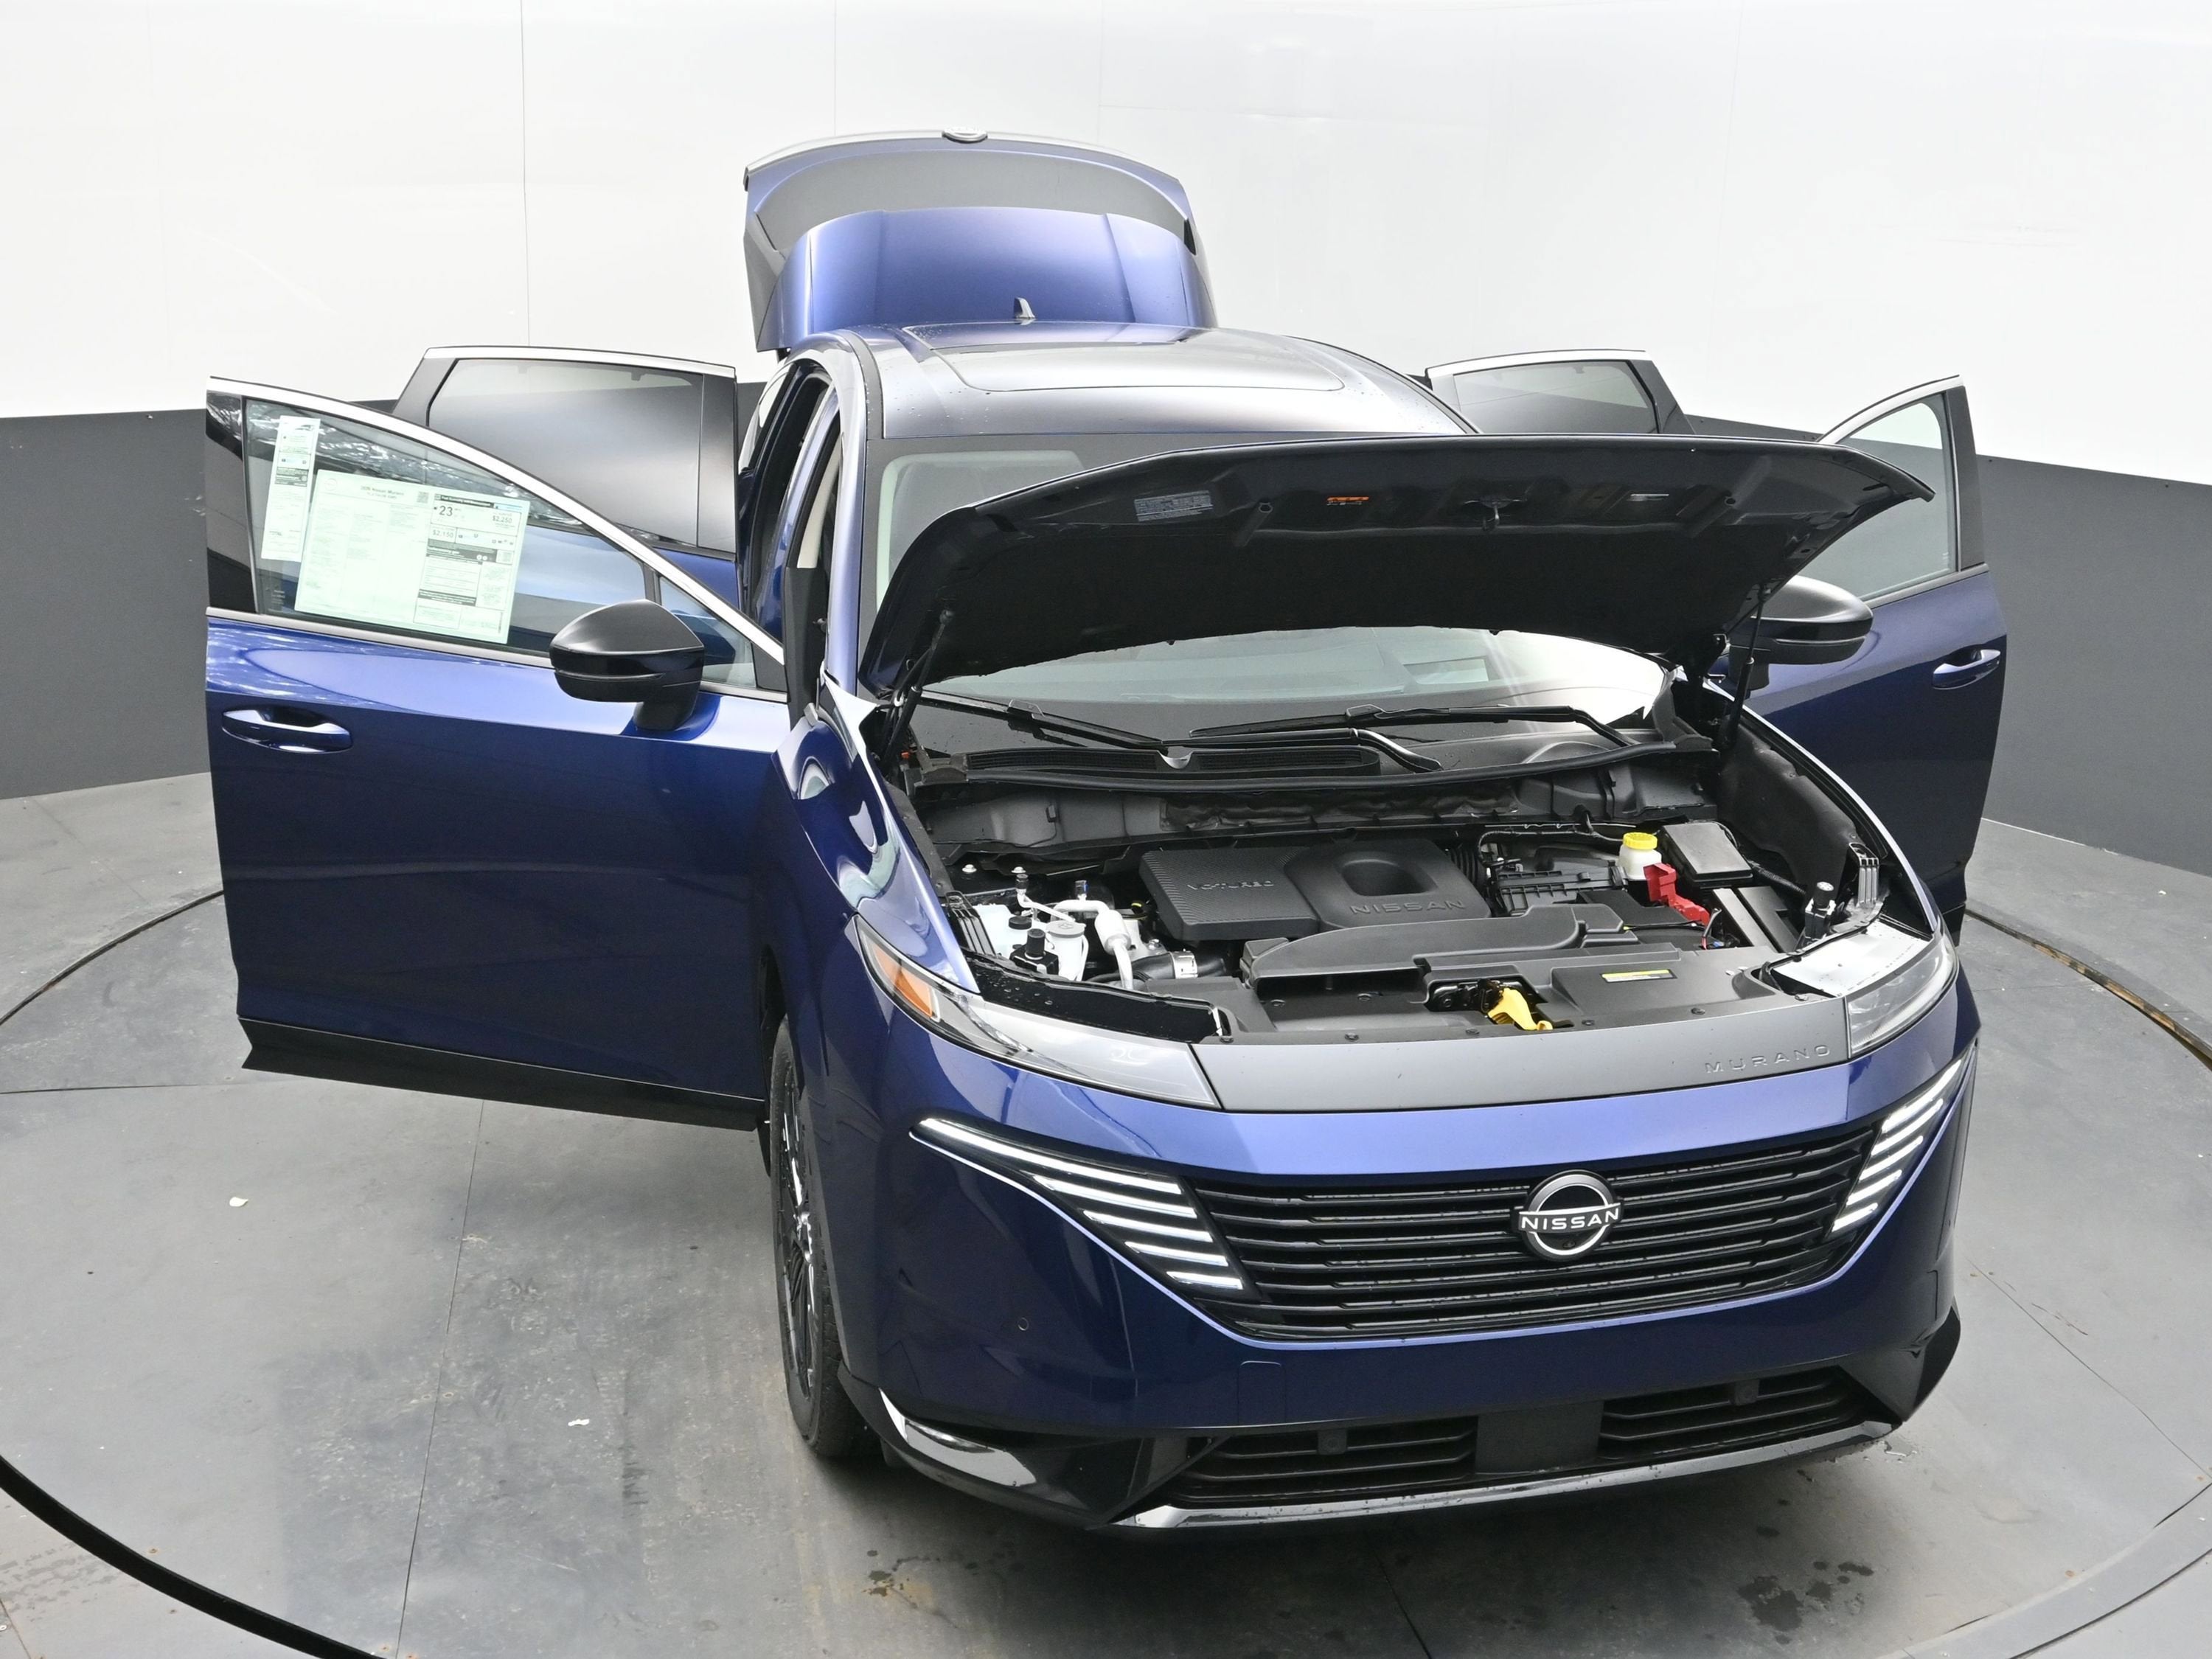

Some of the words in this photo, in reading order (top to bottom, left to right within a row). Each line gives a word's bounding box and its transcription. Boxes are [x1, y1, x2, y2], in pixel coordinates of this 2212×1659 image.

[439, 505, 453, 517] 23
[1349, 899, 1466, 915] NISSAN
[1704, 1044, 1831, 1074] MURANO
[1521, 1207, 1619, 1231] NISSAN
